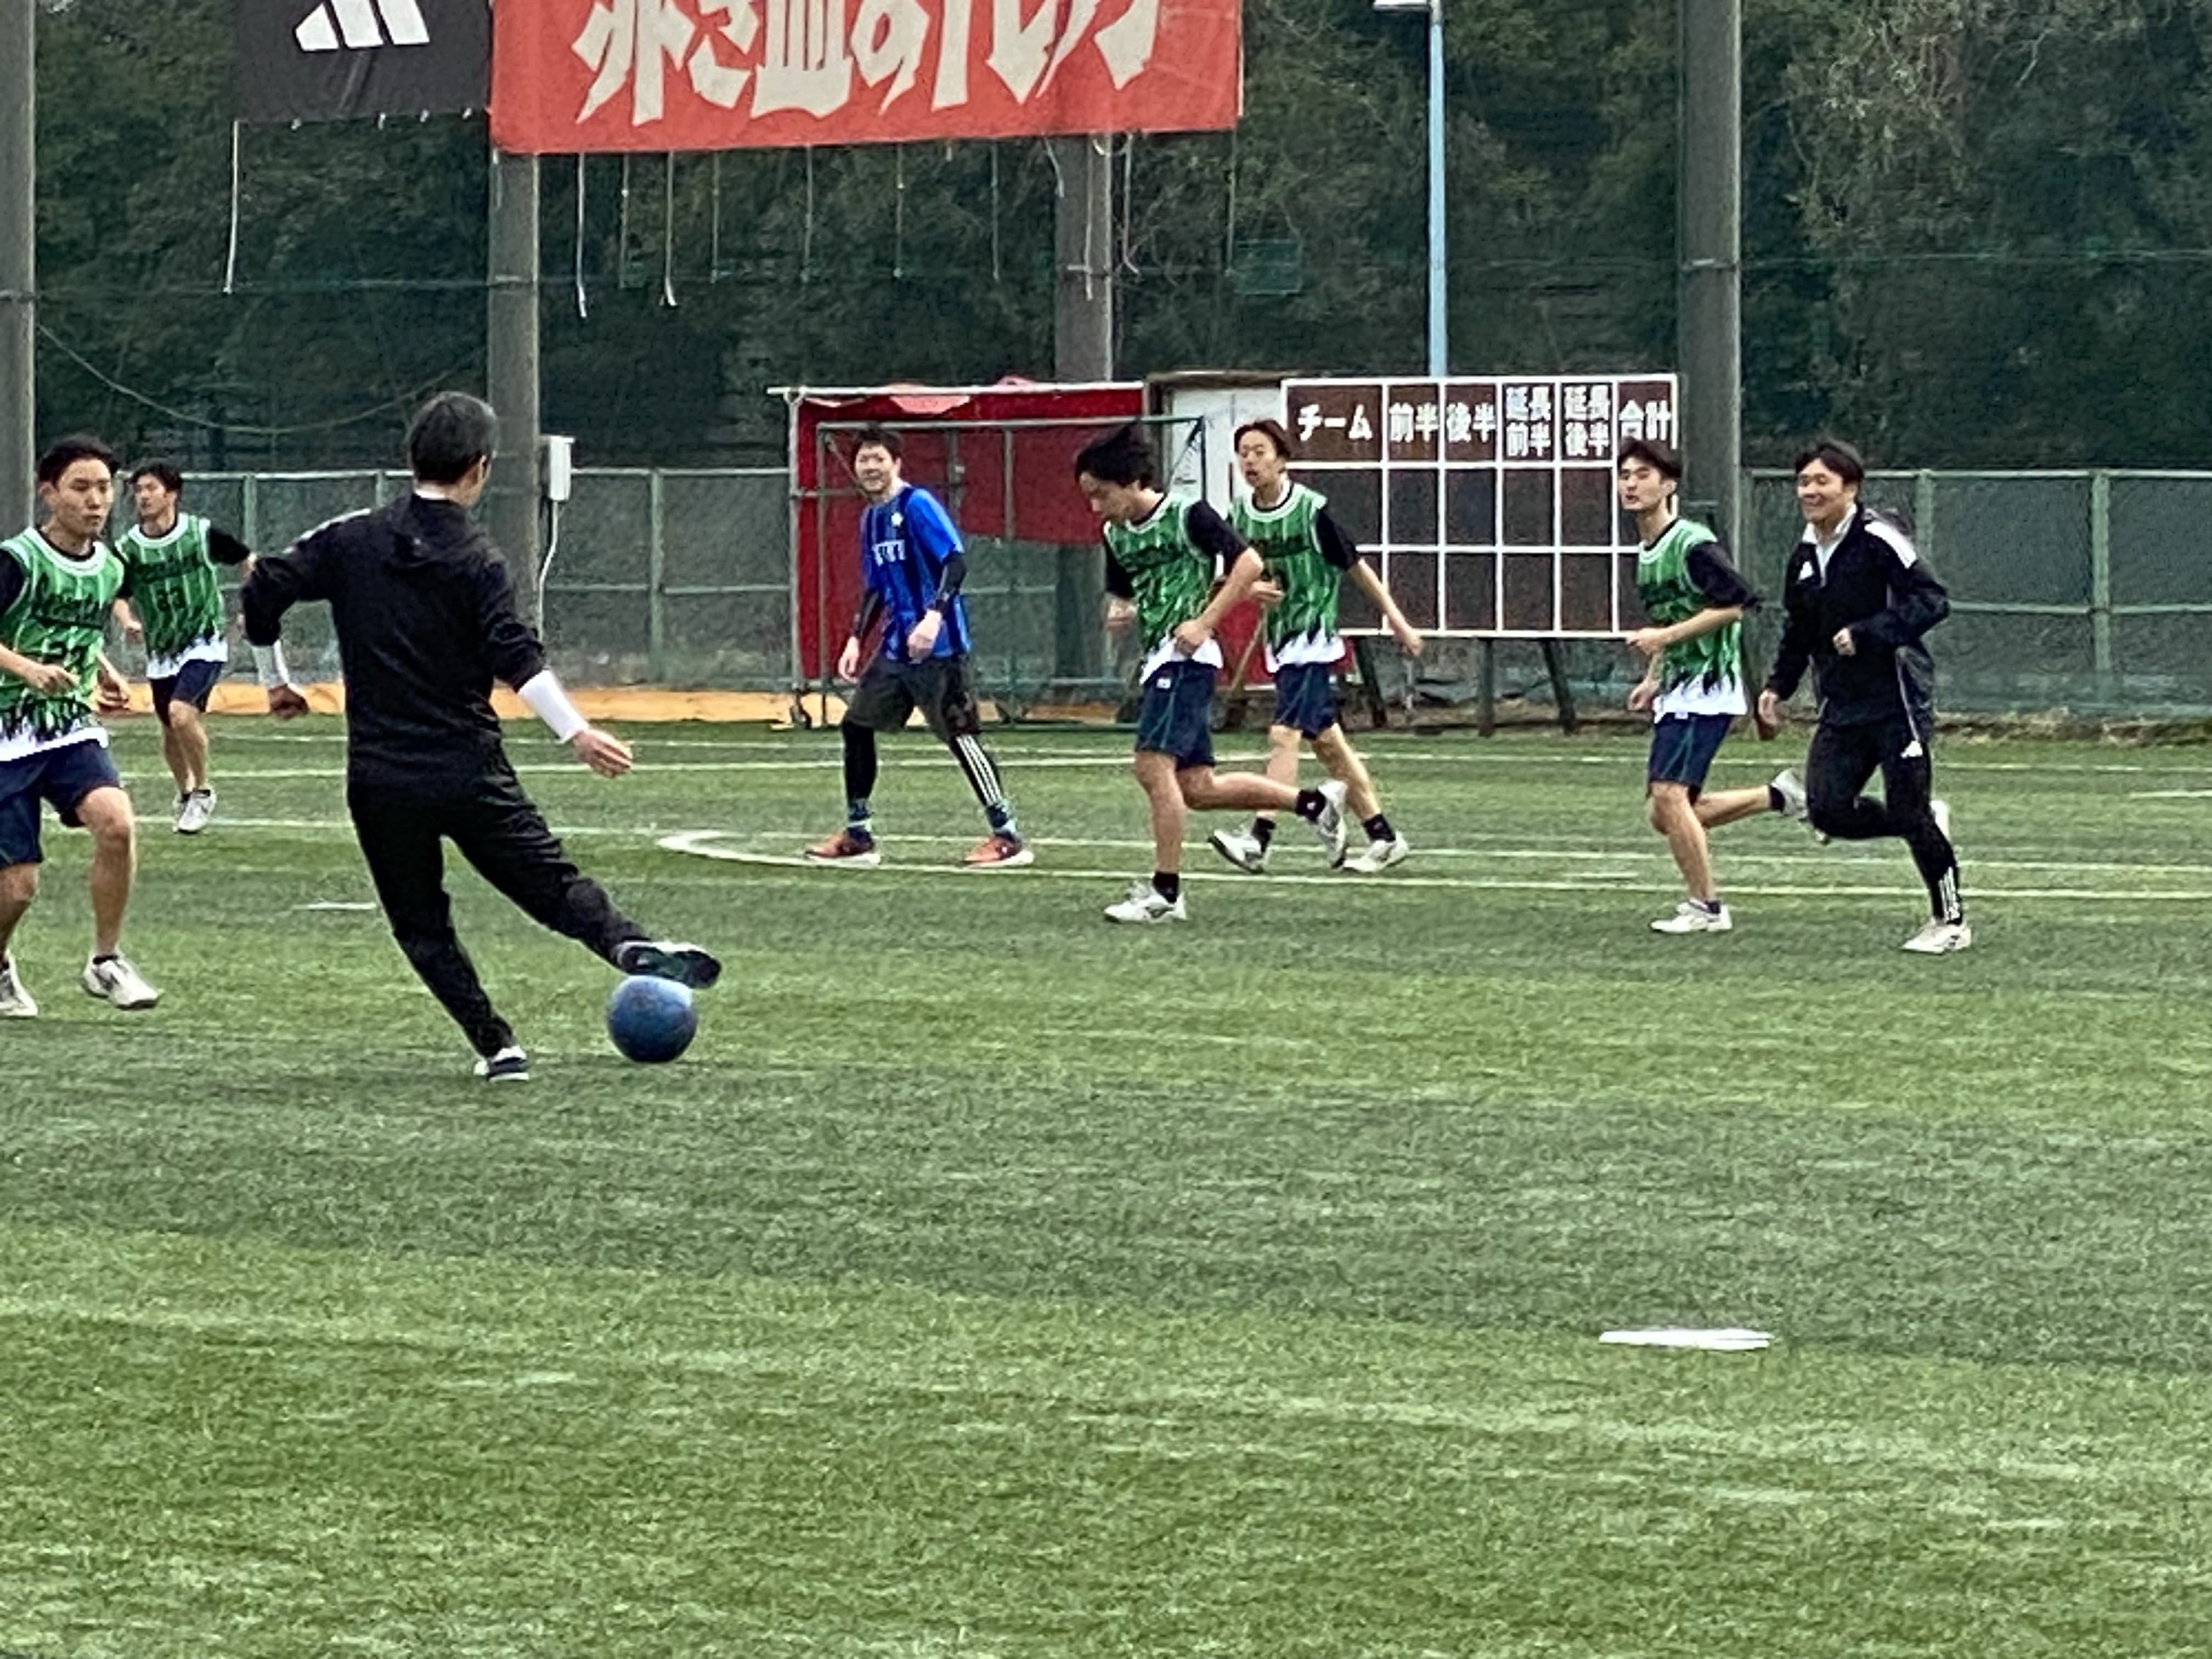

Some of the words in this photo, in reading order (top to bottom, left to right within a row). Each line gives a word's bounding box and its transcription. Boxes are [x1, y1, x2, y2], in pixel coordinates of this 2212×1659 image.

[1506, 386, 1551, 421] 延長
[1564, 385, 1610, 421] 延長
[1619, 399, 1672, 441] 合計
[1297, 404, 1373, 441] チーム
[1389, 403, 1439, 442] 前半
[1446, 403, 1497, 442] 後半
[1506, 422, 1551, 456] 前半
[1565, 422, 1610, 456] 後半
